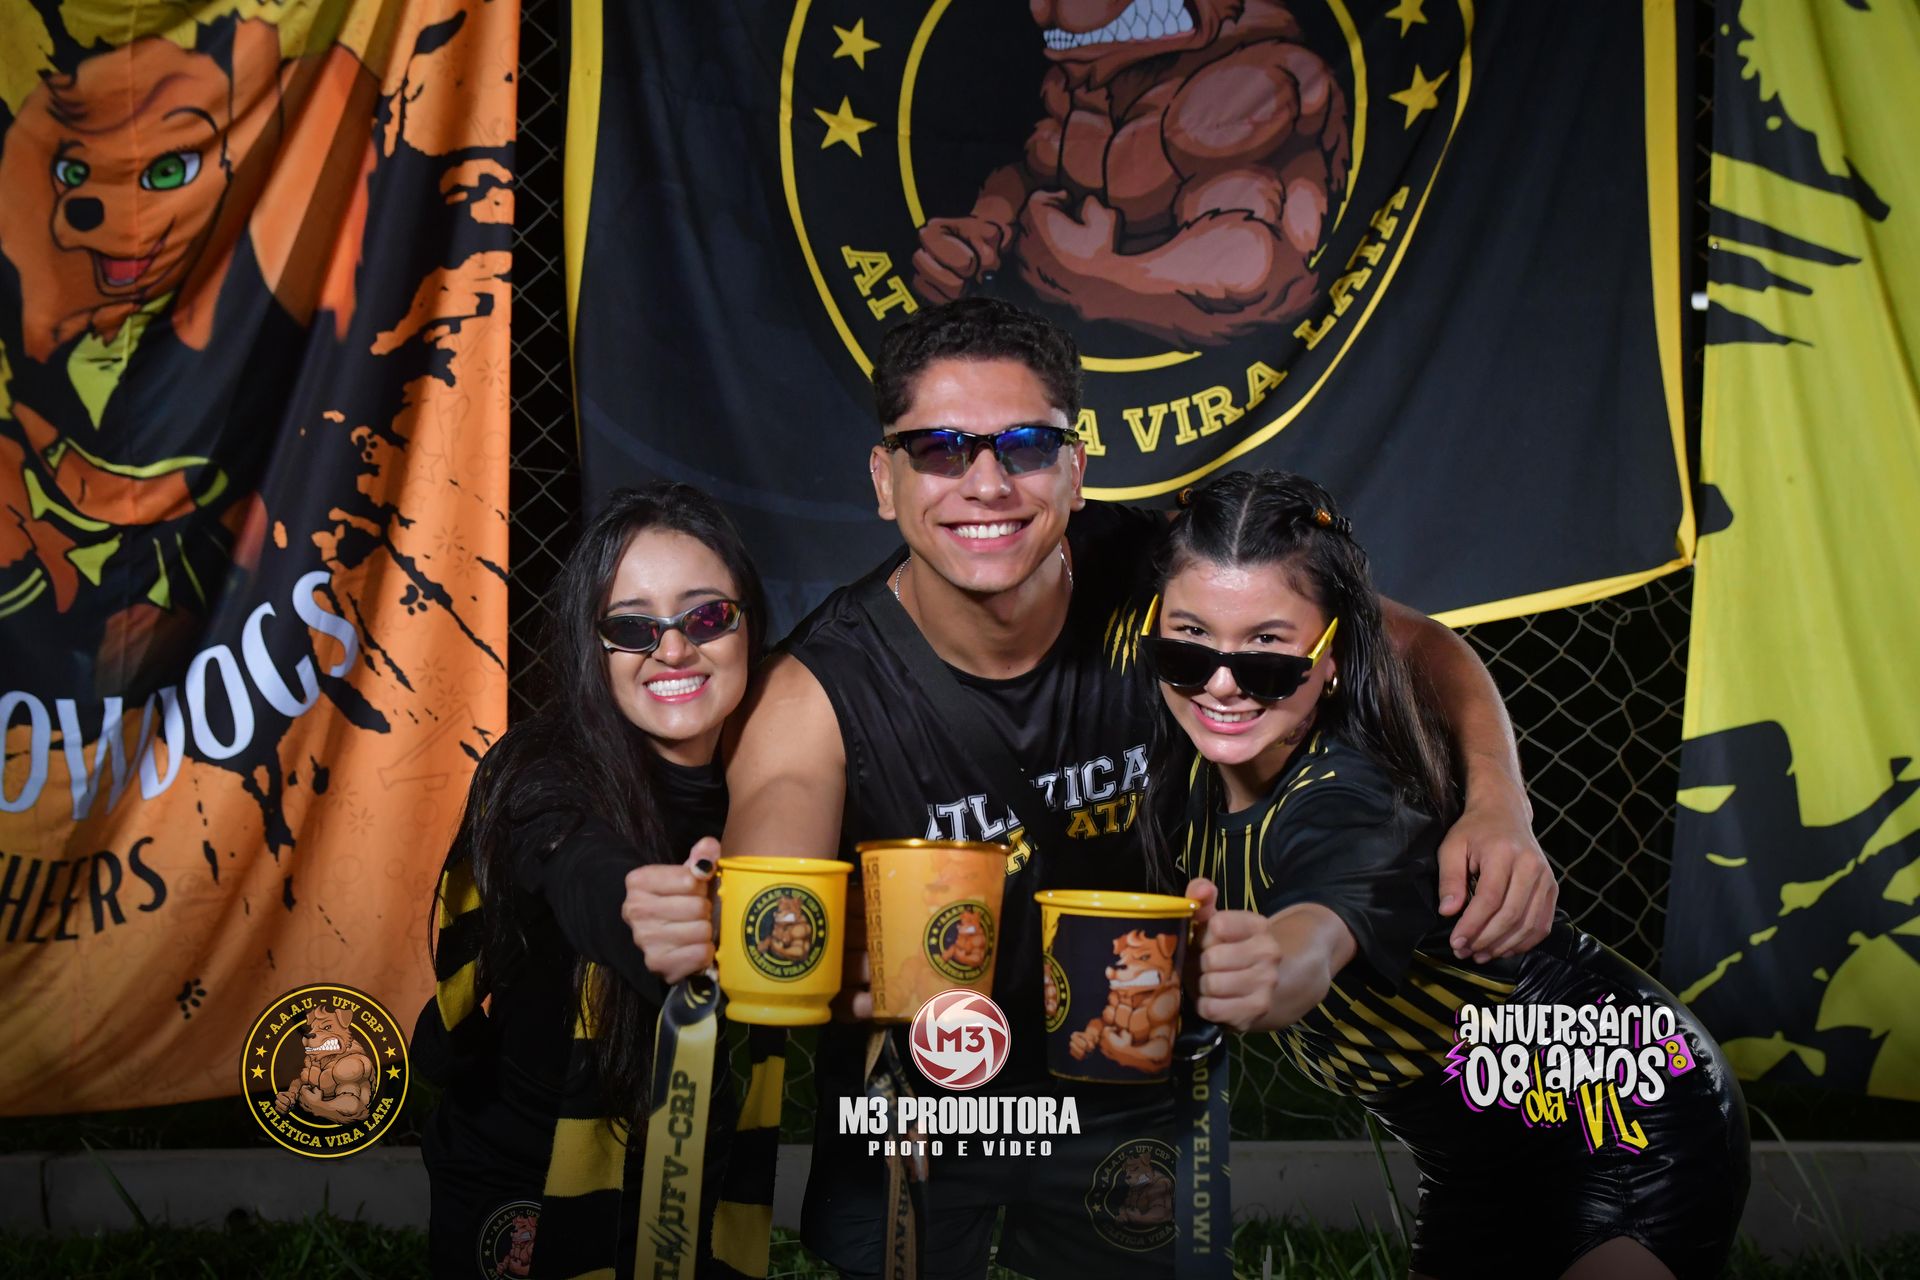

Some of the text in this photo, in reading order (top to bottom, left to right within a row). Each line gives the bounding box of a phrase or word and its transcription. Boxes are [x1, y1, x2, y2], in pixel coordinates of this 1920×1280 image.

[1123, 186, 1410, 453] VIRA LATA
[0, 836, 167, 944] HEERS
[1193, 1111, 1211, 1254] YELLOW!
